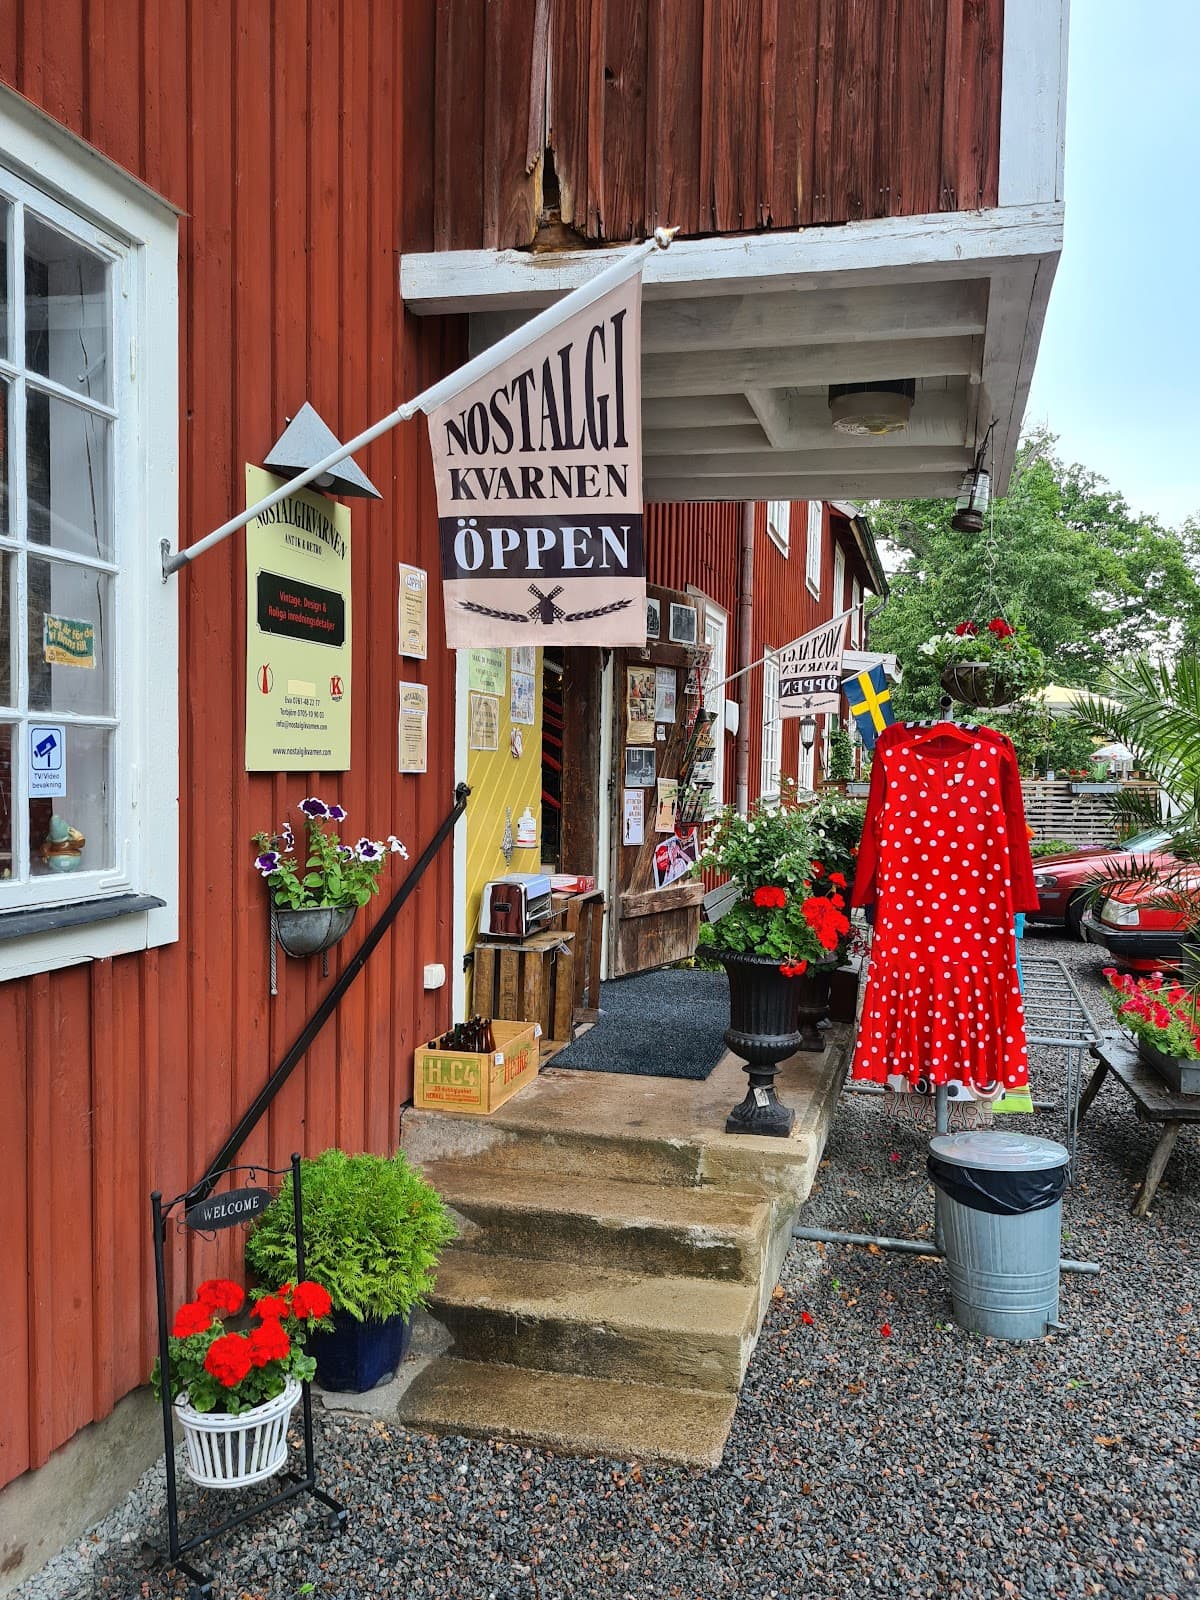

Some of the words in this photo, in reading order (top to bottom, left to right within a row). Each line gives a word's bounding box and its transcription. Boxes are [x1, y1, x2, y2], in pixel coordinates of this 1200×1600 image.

[443, 308, 628, 456] NOSTALGI
[448, 464, 628, 500] KVARNEN
[256, 498, 346, 560] NOSTALGIKVARNEN
[453, 518, 631, 571] ÖPPEN
[268, 605, 287, 621] Roliga
[287, 610, 335, 631] inredningsdetaljer
[303, 597, 322, 613] Design
[322, 602, 327, 612] &
[32, 781, 62, 789] bevakning
[34, 772, 60, 780] TV/Video
[203, 1195, 260, 1221] WELCOME
